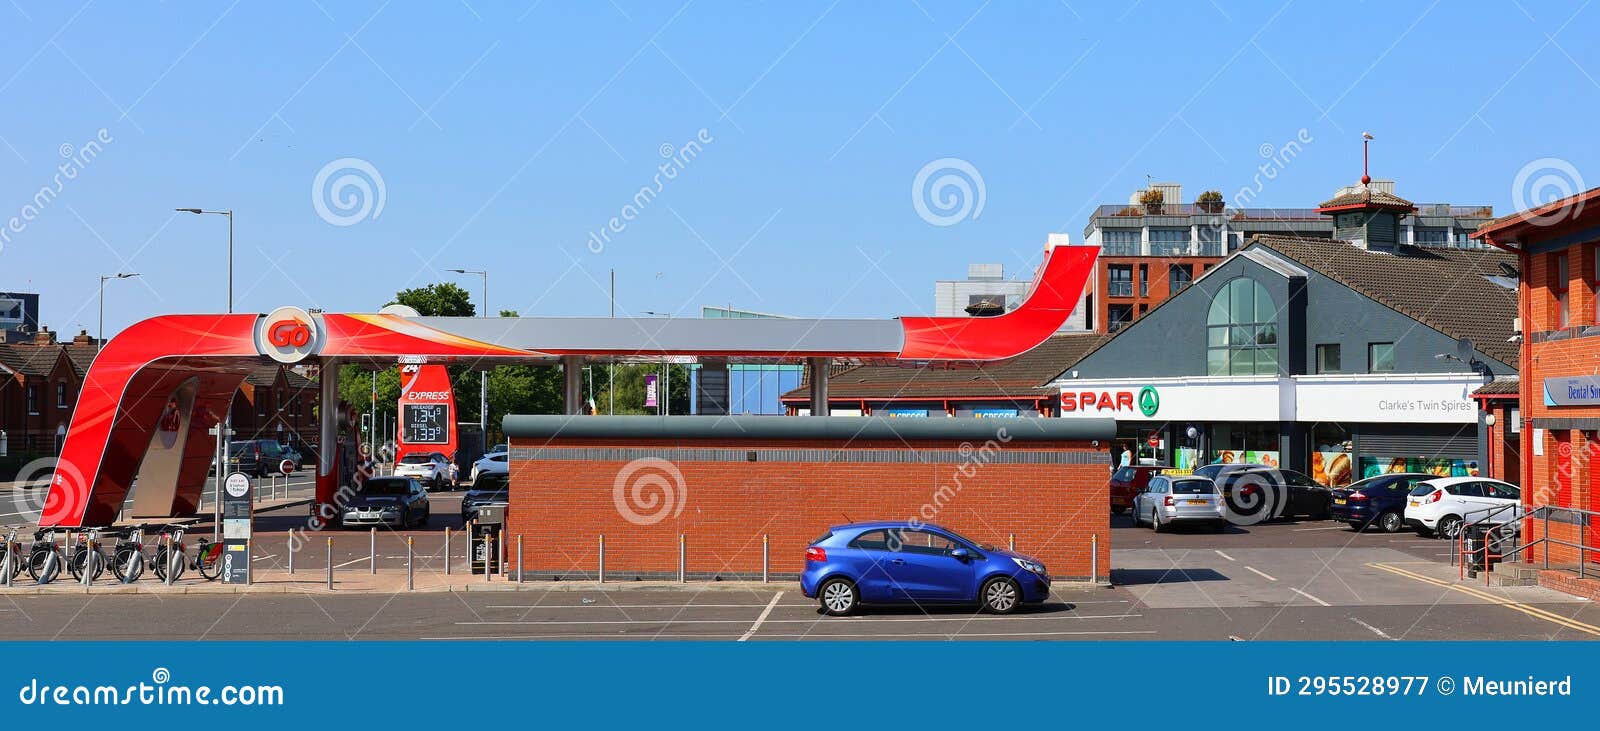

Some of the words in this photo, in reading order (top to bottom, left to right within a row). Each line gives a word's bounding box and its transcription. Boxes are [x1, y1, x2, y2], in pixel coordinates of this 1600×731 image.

[408, 391, 450, 400] EXPRESS
[1568, 384, 1589, 399] Dental
[1060, 391, 1134, 411] SPAR
[1378, 399, 1415, 410] Clarke's
[1416, 400, 1439, 410] Twin
[1441, 399, 1472, 412] Spires
